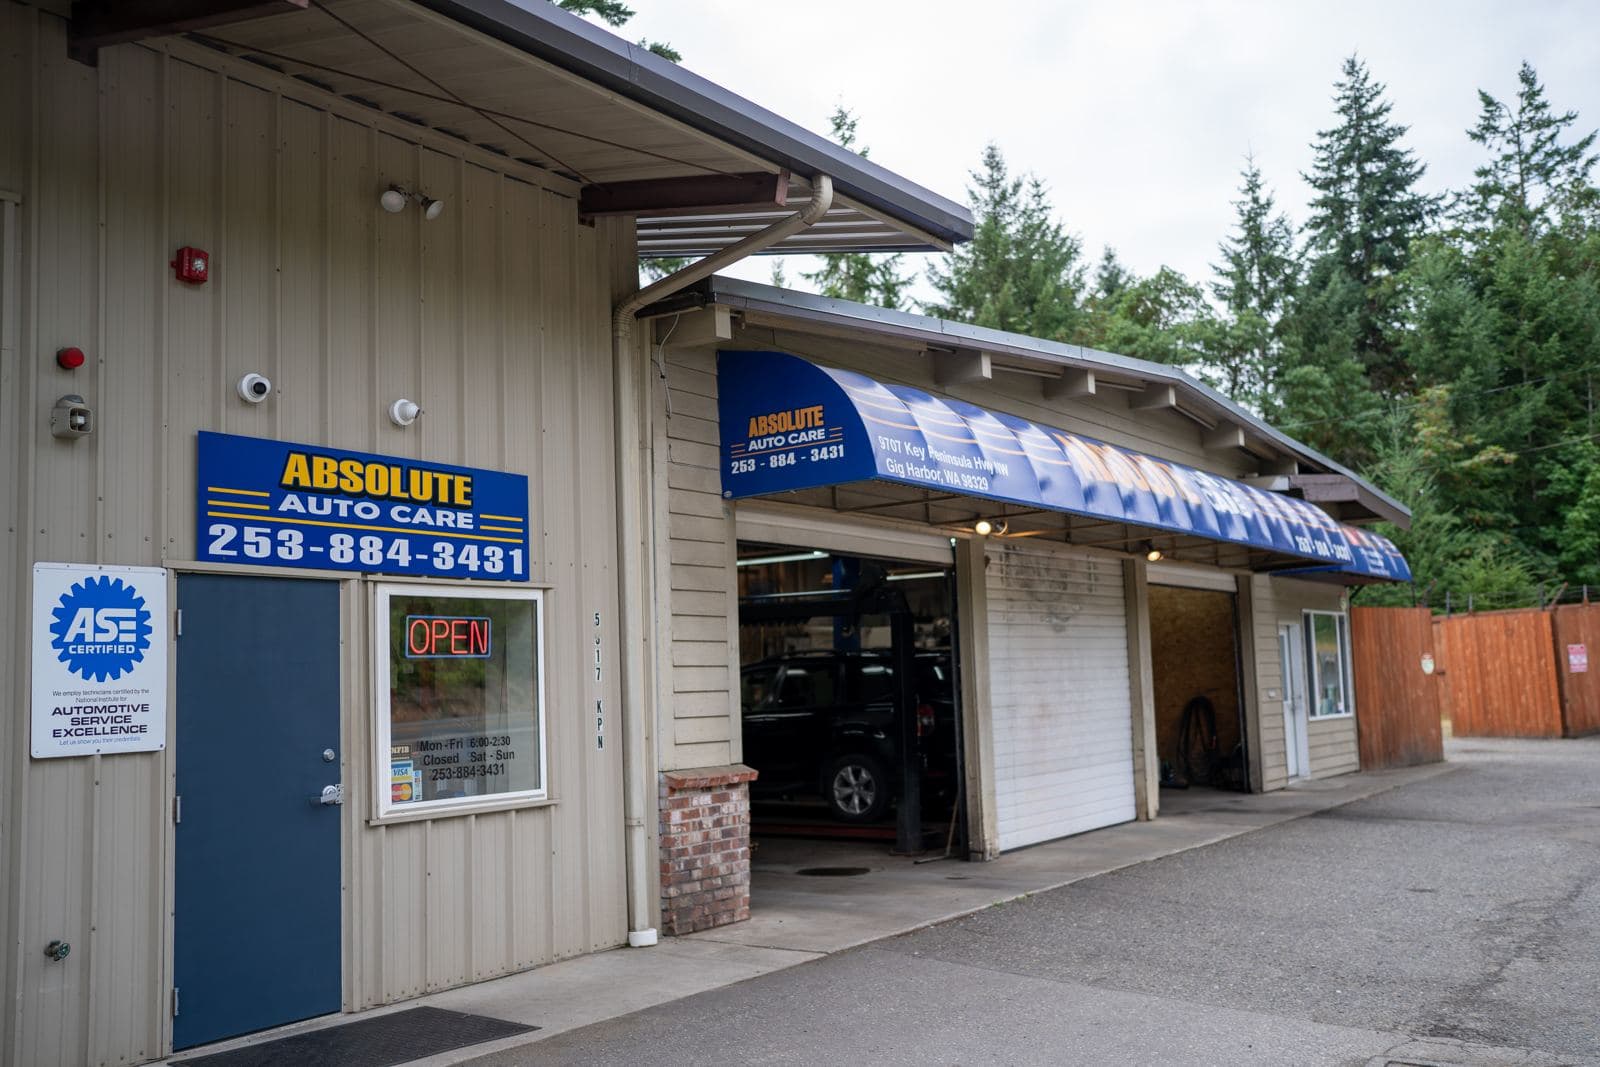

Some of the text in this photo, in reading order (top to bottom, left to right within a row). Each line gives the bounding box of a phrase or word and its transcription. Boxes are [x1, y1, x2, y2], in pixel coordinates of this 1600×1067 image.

[748, 405, 824, 438] ABSOLUTE
[748, 429, 825, 451] AUTO CARE
[878, 436, 901, 453] 9707
[904, 442, 925, 460] Key
[928, 445, 973, 468] Peninsula
[731, 459, 756, 474] 253
[770, 452, 796, 468] 884
[810, 444, 844, 461] 3431
[886, 458, 905, 478] Gig
[906, 462, 944, 484] Harbor,
[944, 469, 961, 486] WA
[280, 452, 473, 507] ABSOLUTE
[278, 494, 474, 530] AUTO CARE
[208, 523, 523, 575] 253-884-3431
[63, 607, 137, 643] ASE
[410, 619, 488, 654] OPEN
[68, 644, 135, 654] CERTIFIED
[52, 704, 150, 716] AUTOMOTIVE
[70, 715, 132, 726] SERVICE
[52, 724, 147, 738] EXCELLENCE
[394, 768, 408, 776] VISA
[424, 753, 459, 766] Closed
[470, 751, 486, 762] Sat
[496, 750, 514, 760] Sun
[432, 763, 505, 781] 253-884-3431
